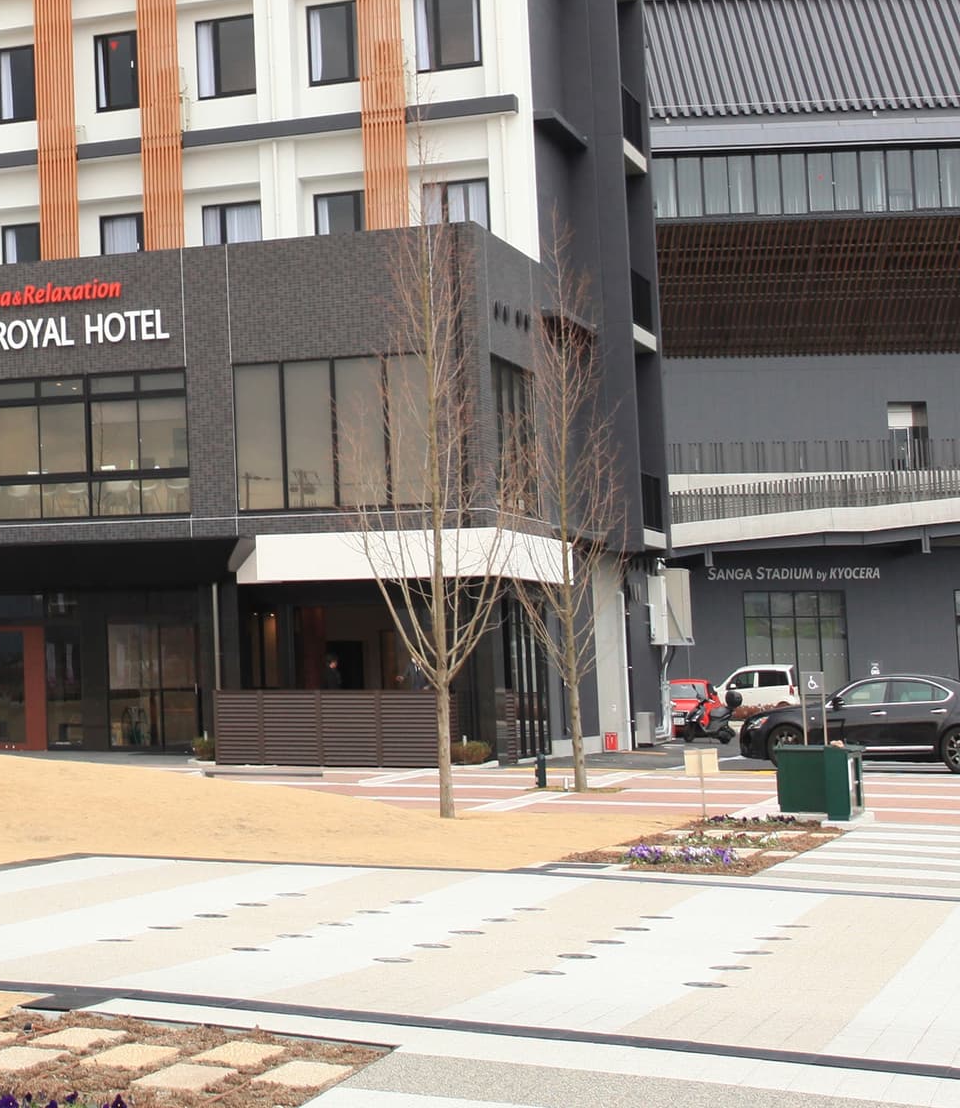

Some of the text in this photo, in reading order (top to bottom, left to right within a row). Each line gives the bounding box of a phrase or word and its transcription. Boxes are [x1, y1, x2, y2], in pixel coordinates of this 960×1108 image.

[84, 309, 170, 344] HOTEL
[707, 566, 880, 582] SANGA STADIUM by KYOCERA
